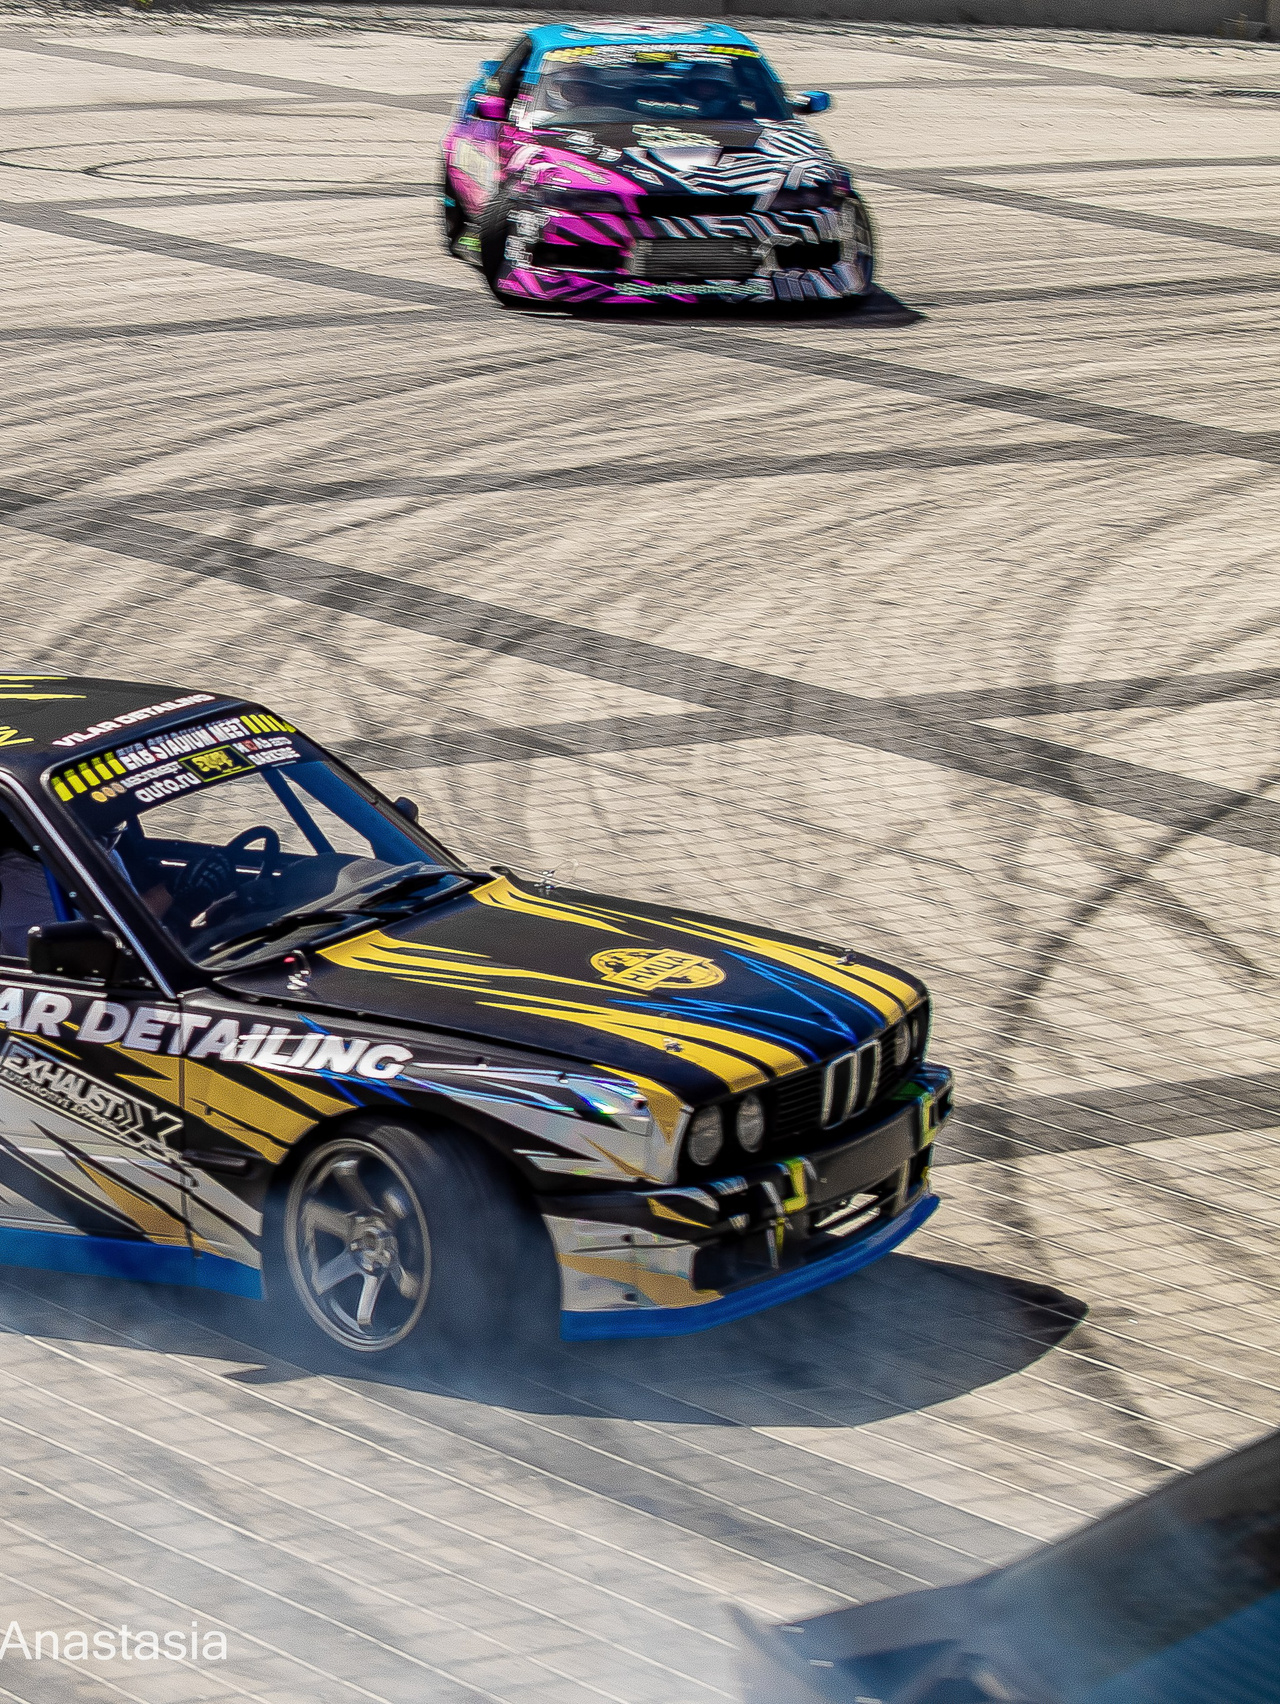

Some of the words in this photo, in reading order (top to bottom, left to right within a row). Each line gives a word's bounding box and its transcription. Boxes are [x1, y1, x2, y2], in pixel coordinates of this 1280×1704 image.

[51, 719, 122, 748] VILAR
[113, 693, 216, 726] DETAILING
[135, 771, 203, 803] auto.ru
[624, 955, 695, 984] НИЦА
[75, 1000, 414, 1080] DETAILING
